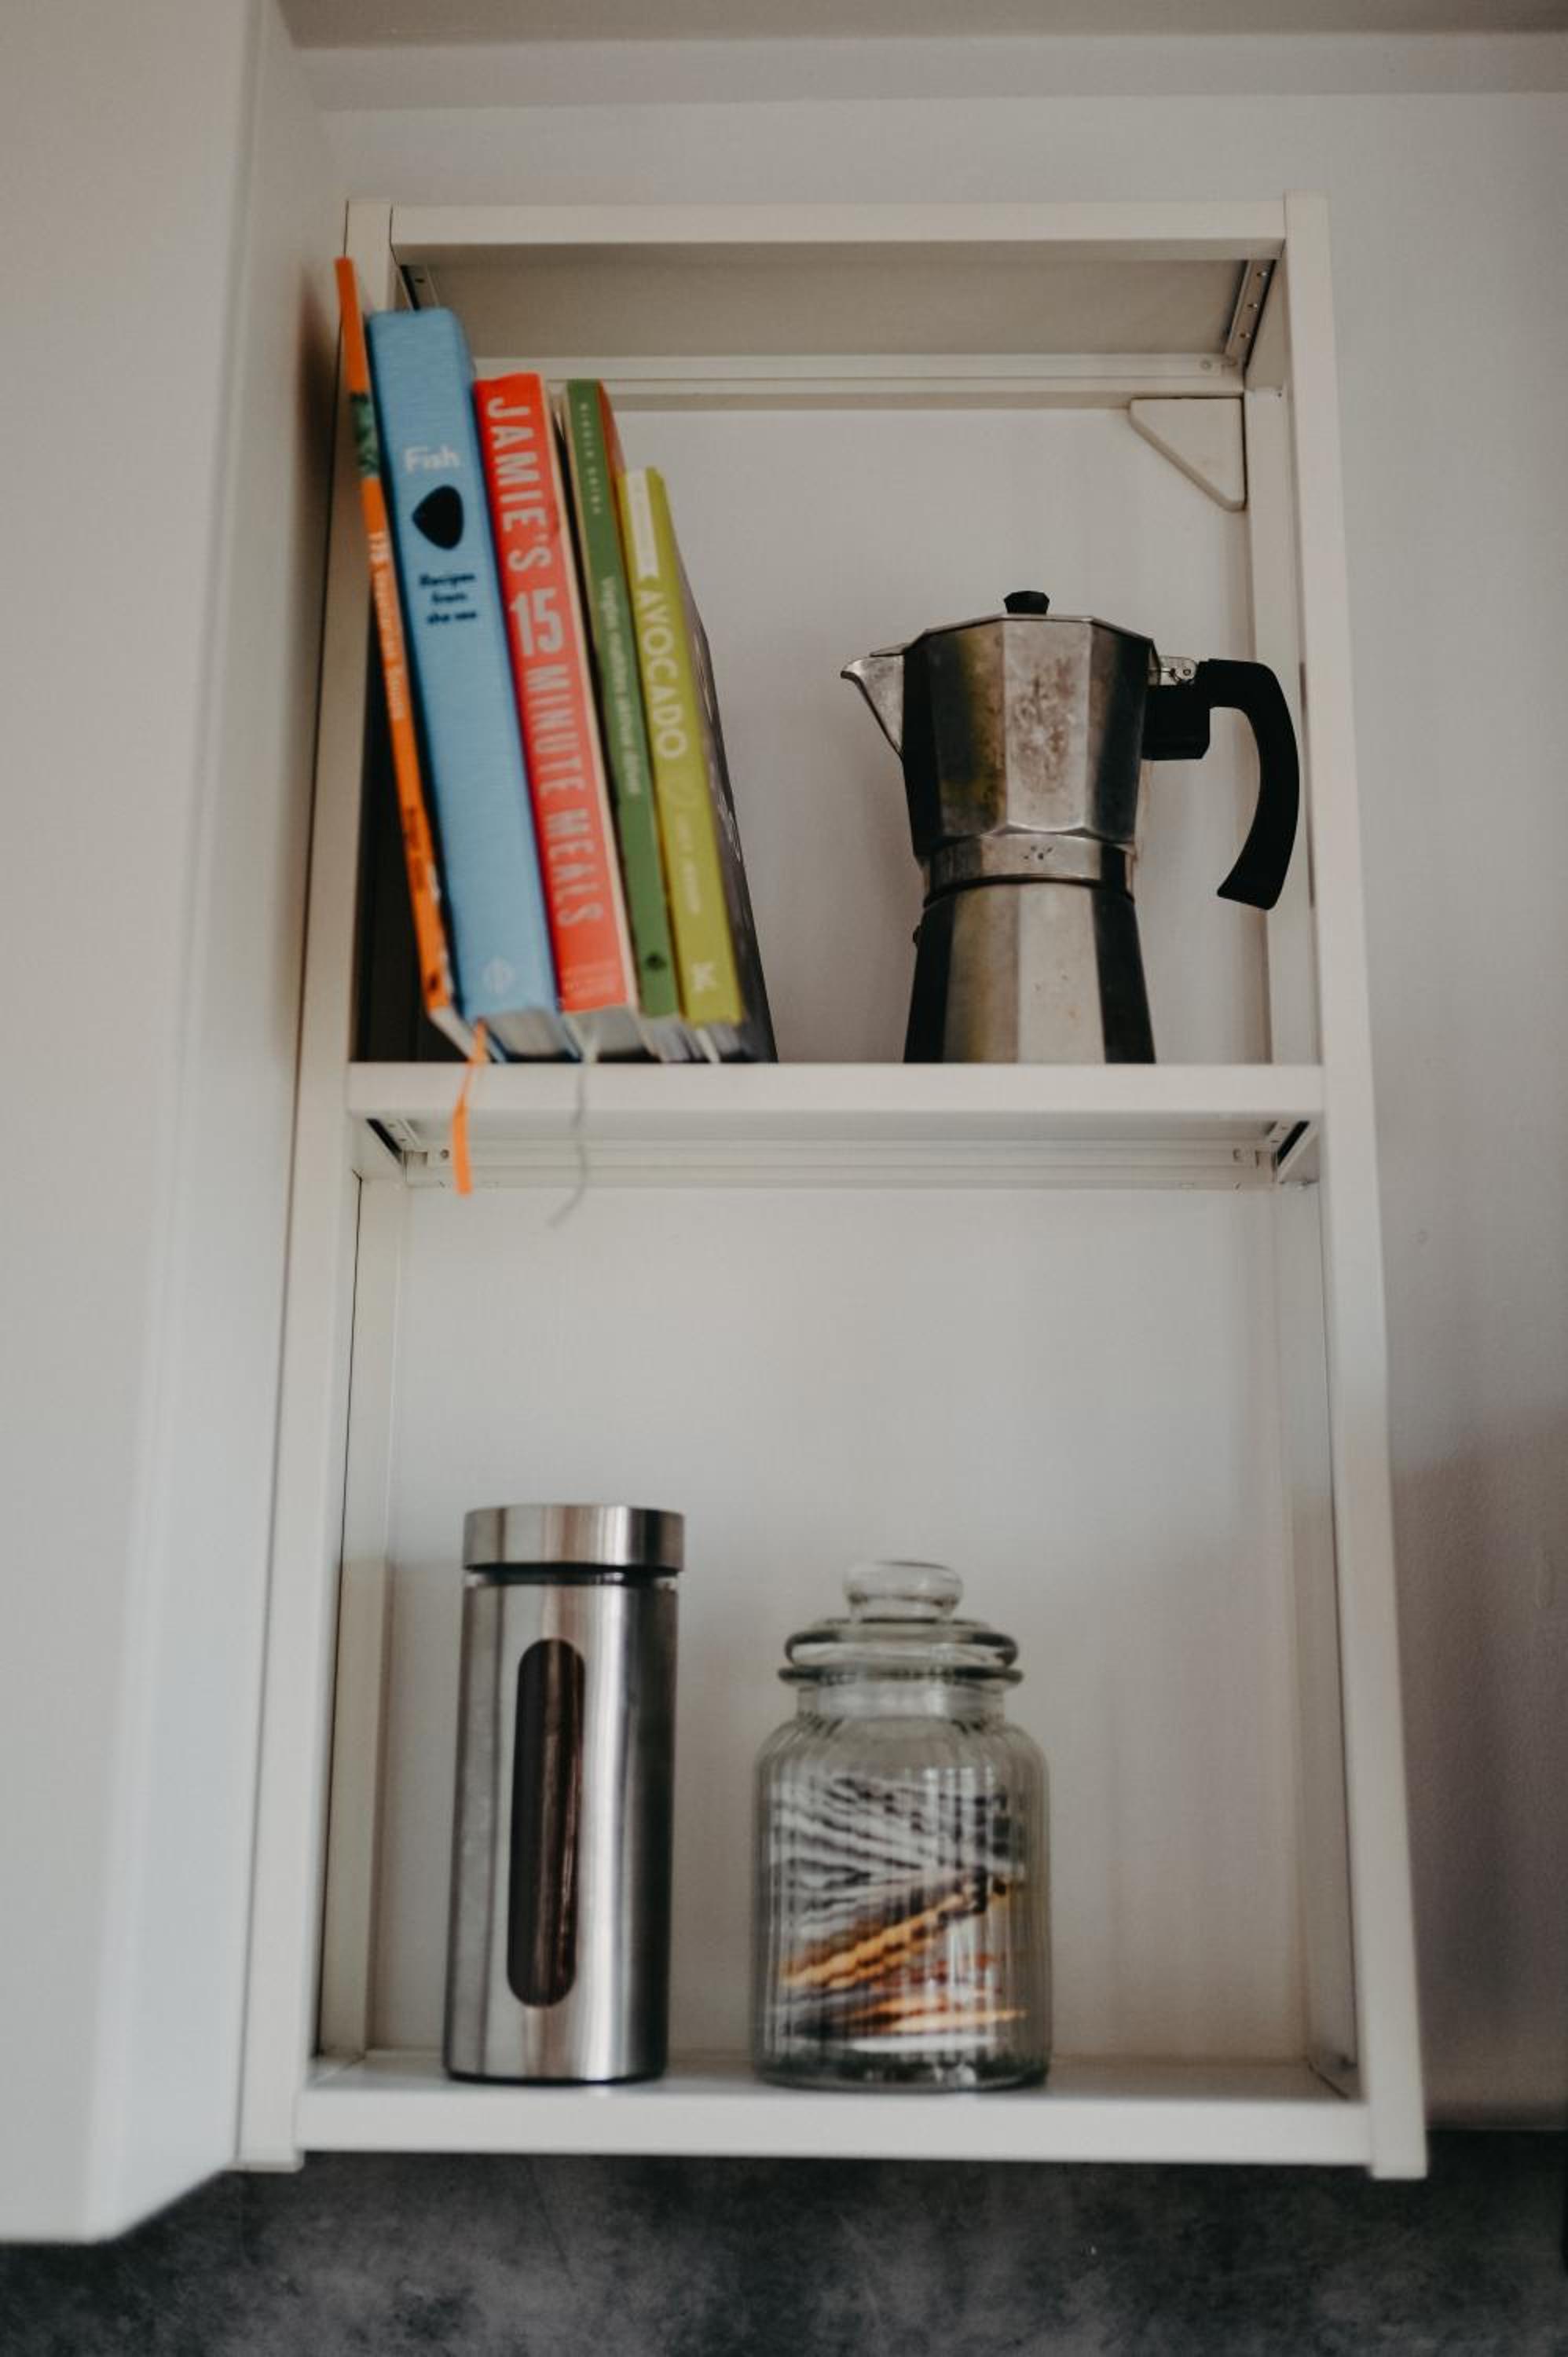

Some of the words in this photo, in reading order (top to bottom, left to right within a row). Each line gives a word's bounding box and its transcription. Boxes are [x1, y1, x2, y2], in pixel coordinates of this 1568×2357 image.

[405, 445, 462, 474] Fish
[486, 396, 552, 571] JAMIE'S
[510, 587, 564, 657] 15
[639, 589, 690, 760] AVOCADO
[525, 663, 585, 799] MINUTE
[544, 806, 605, 928] MEALS
